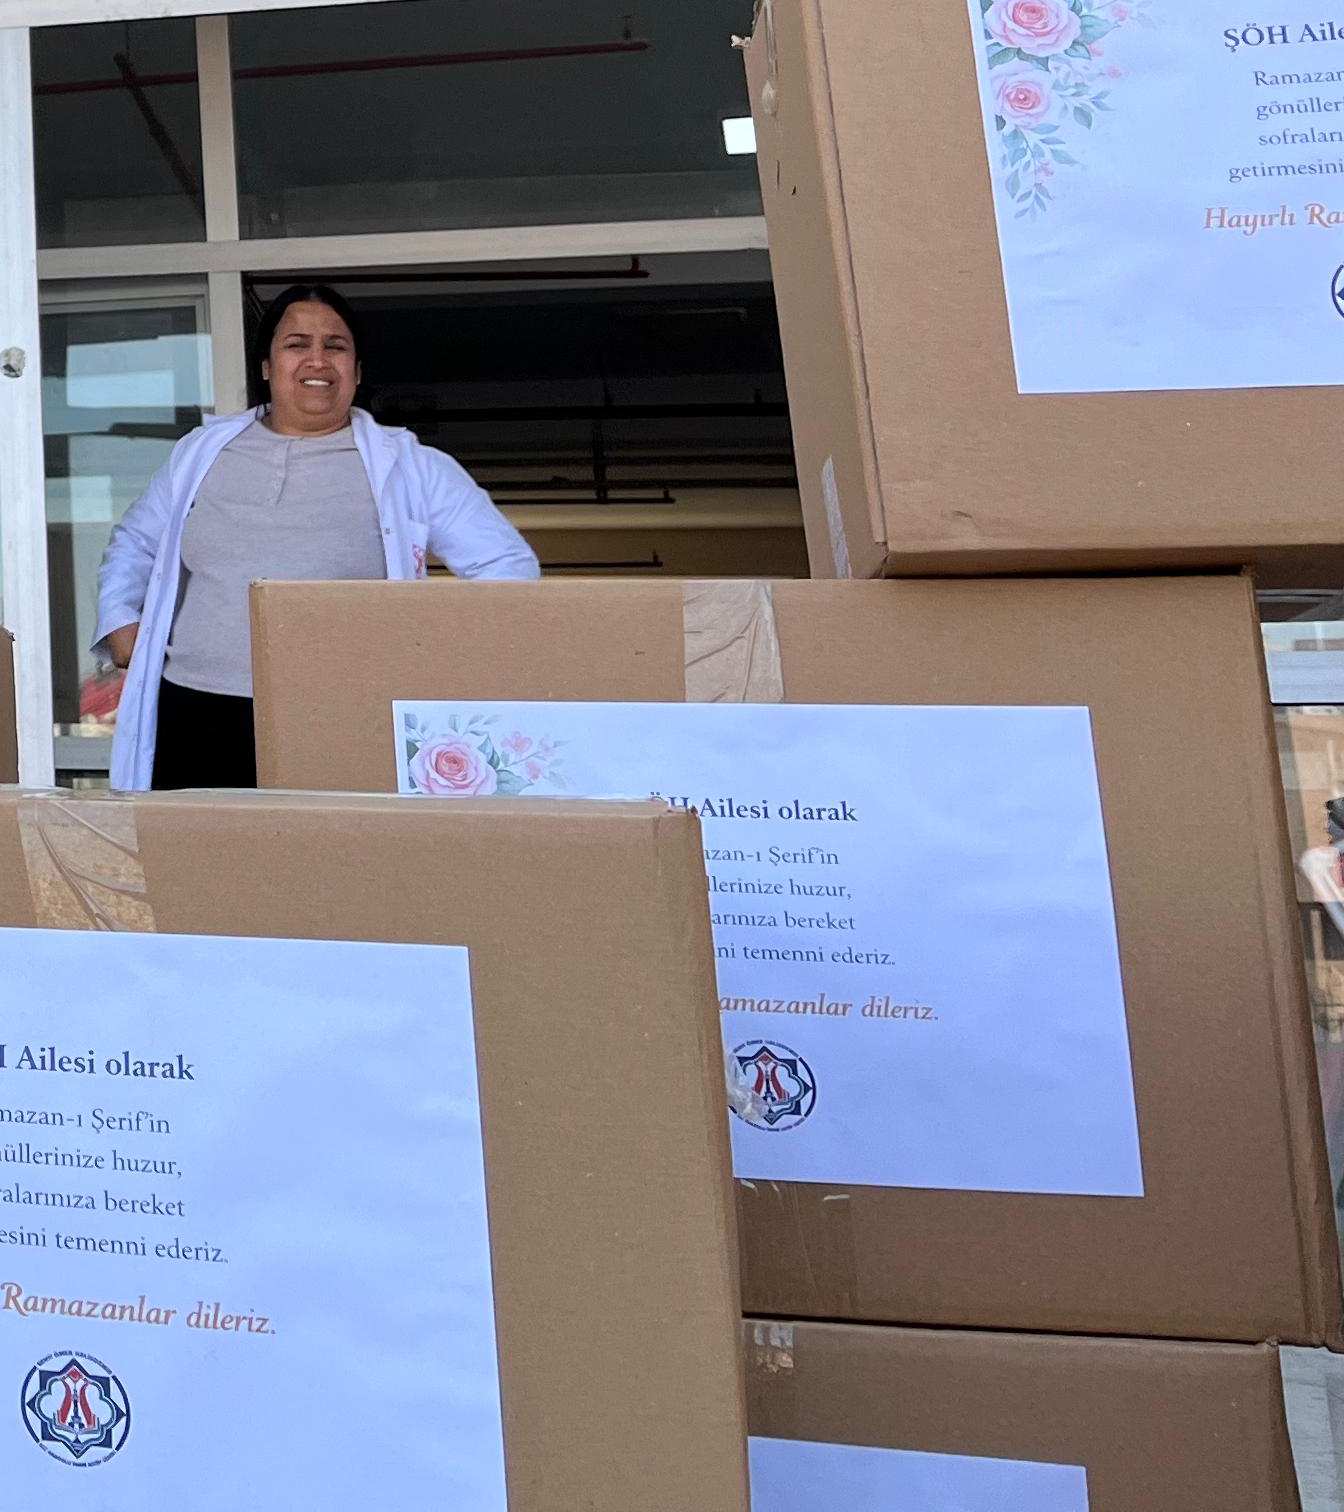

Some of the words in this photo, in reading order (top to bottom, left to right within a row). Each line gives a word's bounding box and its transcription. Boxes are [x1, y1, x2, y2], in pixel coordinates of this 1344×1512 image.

[1224, 23, 1290, 52] ŞÖH
[1204, 204, 1297, 236] Hayırlı
[700, 798, 770, 819] Ailesi
[778, 800, 857, 821] olarak
[788, 878, 851, 900] huzur,
[784, 910, 855, 930] bereket
[743, 946, 824, 962] temenni
[831, 946, 895, 965] ederiz.
[718, 994, 854, 1018] amazanlar
[858, 996, 938, 1020] dileriz.
[15, 1046, 96, 1074] Ailesi
[105, 1051, 194, 1080] olarak
[112, 1150, 181, 1178] huzur,
[104, 1190, 184, 1216] bereket
[55, 1231, 147, 1260] temenni
[155, 1238, 228, 1263] ederiz.
[0, 1283, 176, 1329] Ramazanlar
[186, 1301, 275, 1334] dileriz.
